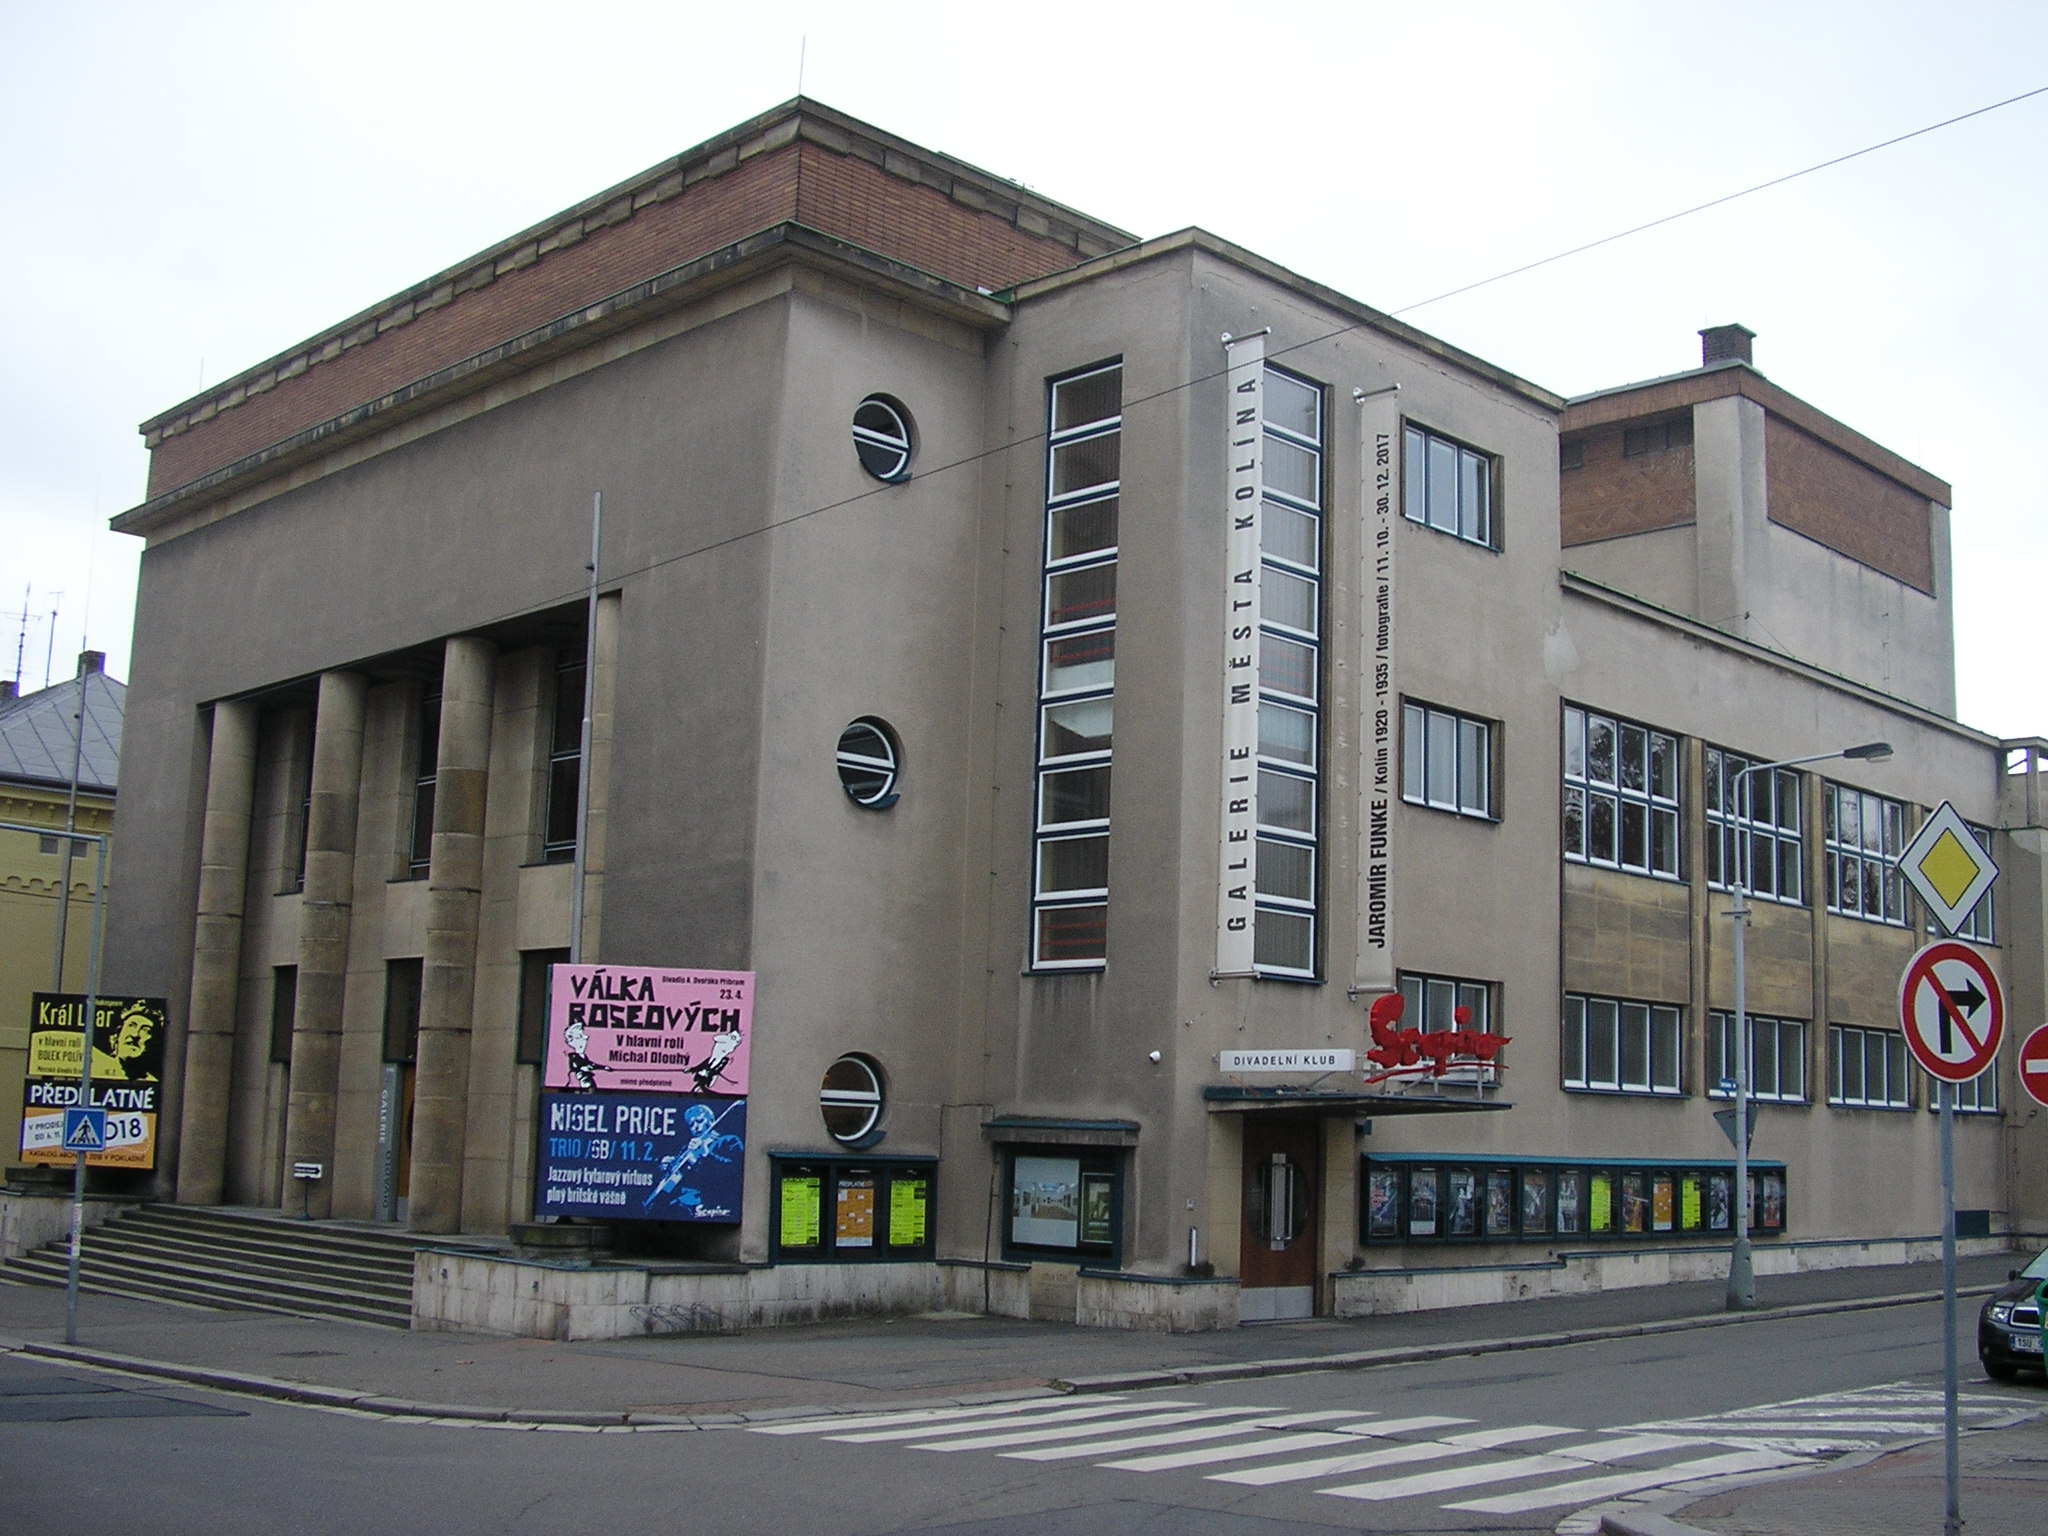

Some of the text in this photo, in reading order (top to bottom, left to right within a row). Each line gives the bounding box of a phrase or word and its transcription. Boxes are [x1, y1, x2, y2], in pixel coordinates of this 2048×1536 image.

[1376, 433, 1389, 467] 2017
[1376, 583, 1391, 651] fotografie
[1229, 569, 1252, 704] MĚSTA
[1376, 662, 1388, 698] 1935
[1375, 707, 1388, 744] 1920
[1374, 747, 1387, 787] Kolín
[1227, 746, 1249, 931] GALERIE
[1369, 798, 1387, 859] FUNKE
[1368, 864, 1387, 949] JAROMÍR
[570, 968, 655, 1002] VÁLKA
[39, 1002, 115, 1028] Král Lar
[568, 1001, 740, 1032] ROSEOVÝCH
[38, 1049, 60, 1061] BOLEK
[609, 1050, 690, 1066] Michal Dlouhý
[616, 1034, 684, 1049] V hlavní roli
[1234, 1054, 1336, 1066] DIVADELNÍ KLUB
[551, 1103, 677, 1136] NIGEL PRICE
[550, 1138, 581, 1159] TRIO
[548, 1166, 653, 1186] Jazzový kytarový virtuos
[546, 1187, 565, 1204] plný
[567, 1186, 598, 1203] britské
